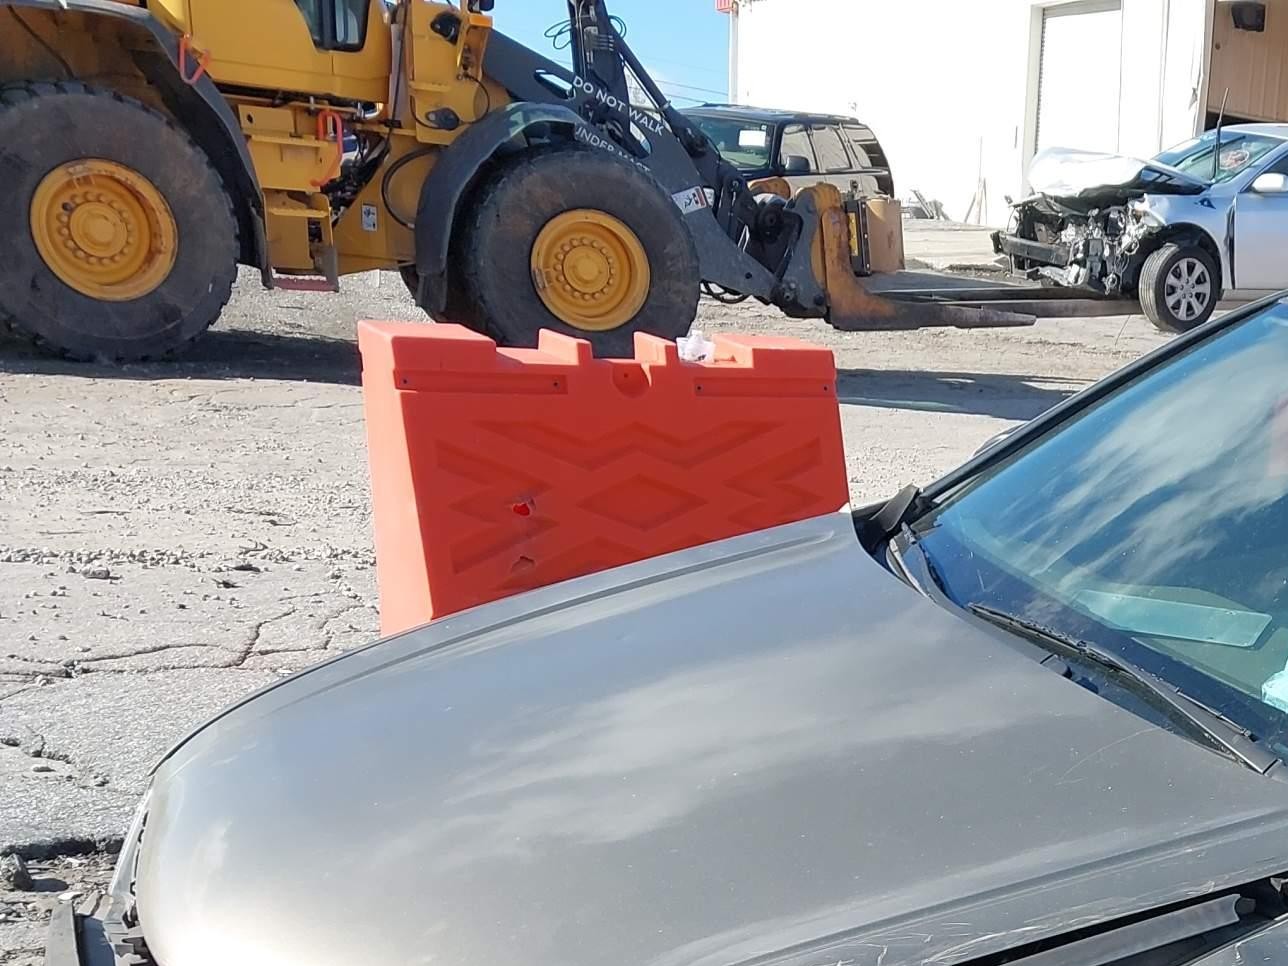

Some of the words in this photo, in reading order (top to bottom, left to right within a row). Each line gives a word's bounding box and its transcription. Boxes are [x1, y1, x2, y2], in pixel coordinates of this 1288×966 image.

[573, 75, 594, 93] DO
[595, 89, 626, 112] NOT
[629, 106, 664, 136] WALK
